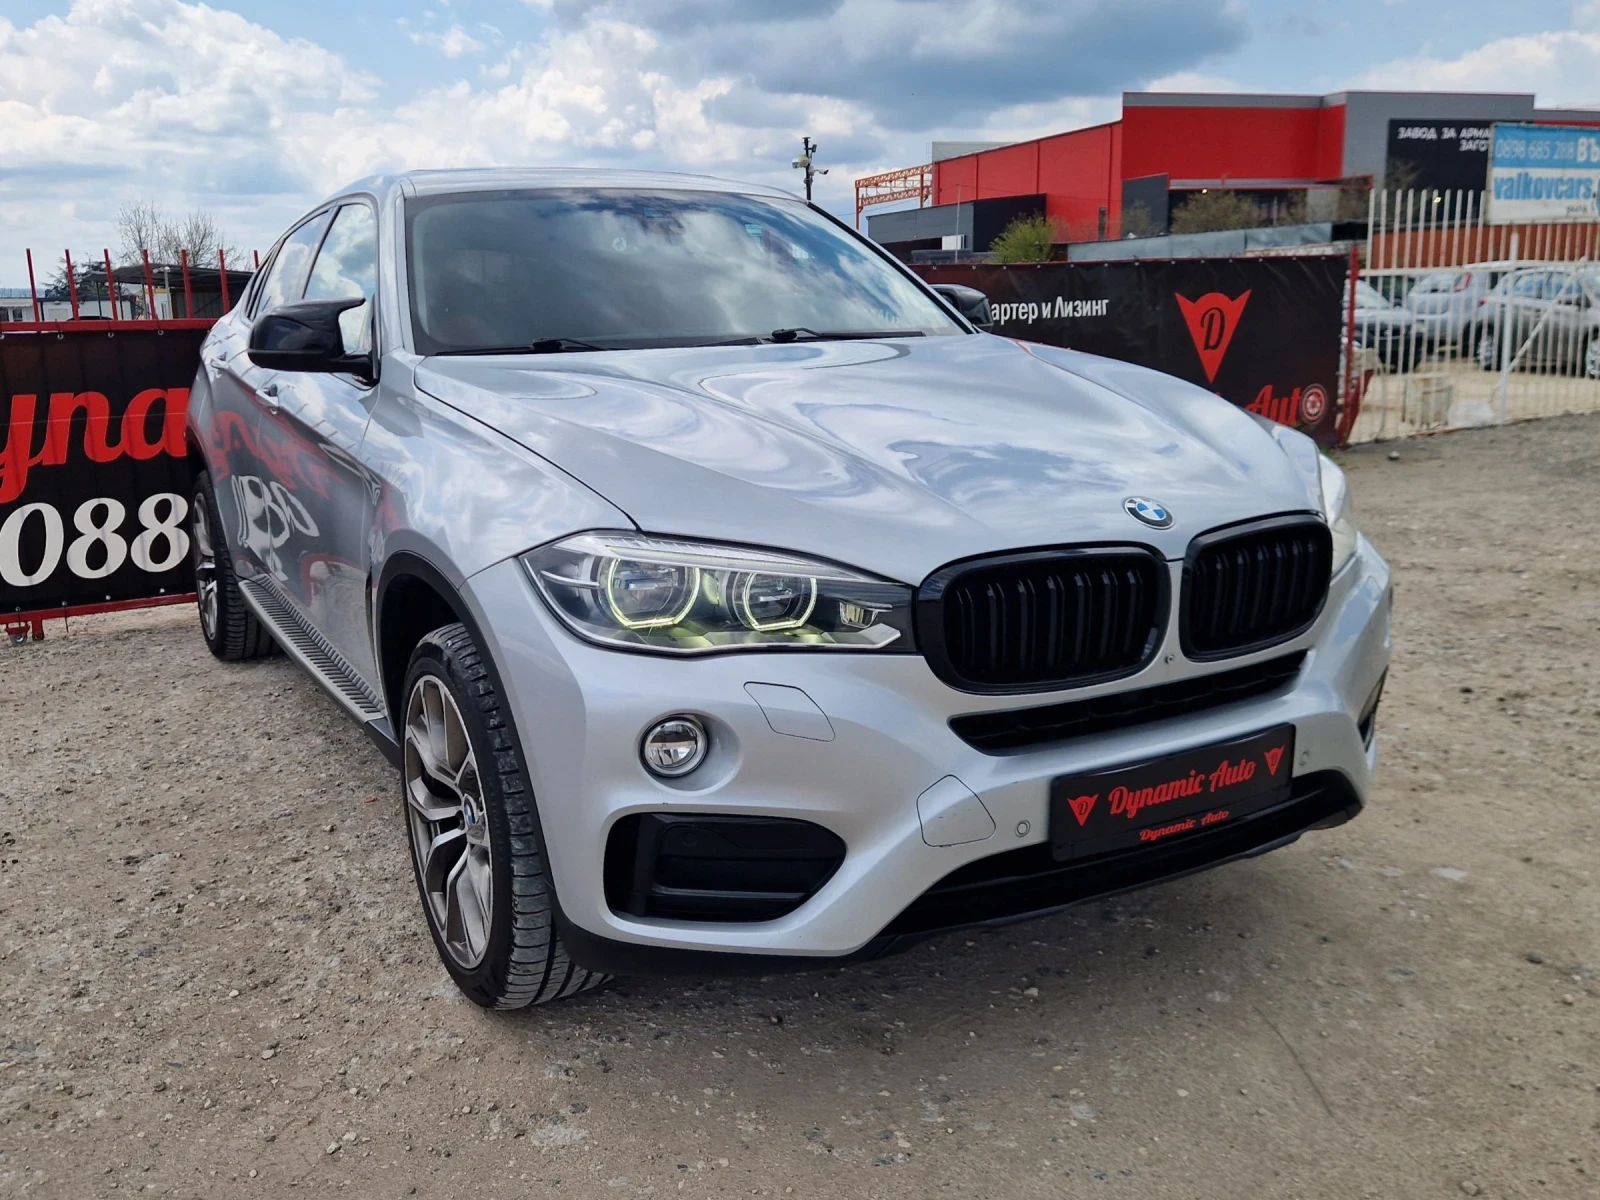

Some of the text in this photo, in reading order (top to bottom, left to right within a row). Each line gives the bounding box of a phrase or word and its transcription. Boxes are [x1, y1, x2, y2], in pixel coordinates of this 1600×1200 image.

[1397, 127, 1438, 140] ЗАВОД
[1441, 127, 1457, 139] ЗА
[991, 296, 1109, 326] артер и Лизинг
[0, 493, 191, 587] 088
[1108, 758, 1257, 819] Dynamic Auto
[1139, 810, 1230, 841] Dynamic Auto
